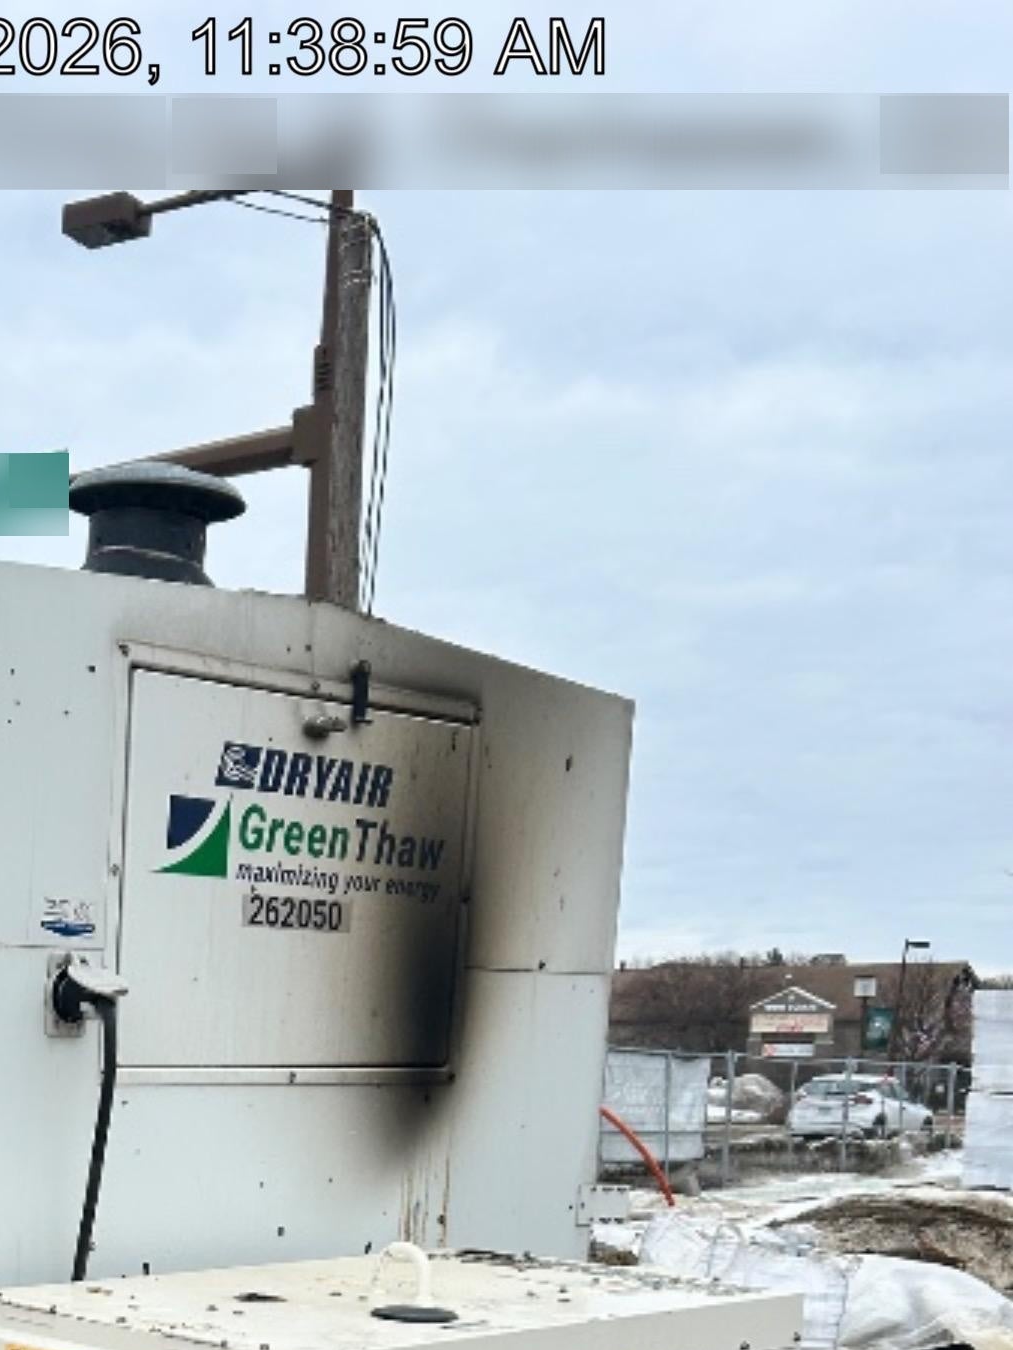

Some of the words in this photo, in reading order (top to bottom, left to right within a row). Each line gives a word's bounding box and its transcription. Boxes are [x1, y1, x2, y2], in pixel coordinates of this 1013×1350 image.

[257, 748, 393, 808] DRYAIR
[236, 861, 339, 895] maximizing
[343, 875, 381, 895] your
[385, 878, 441, 903] energy
[248, 894, 343, 930] 262050
